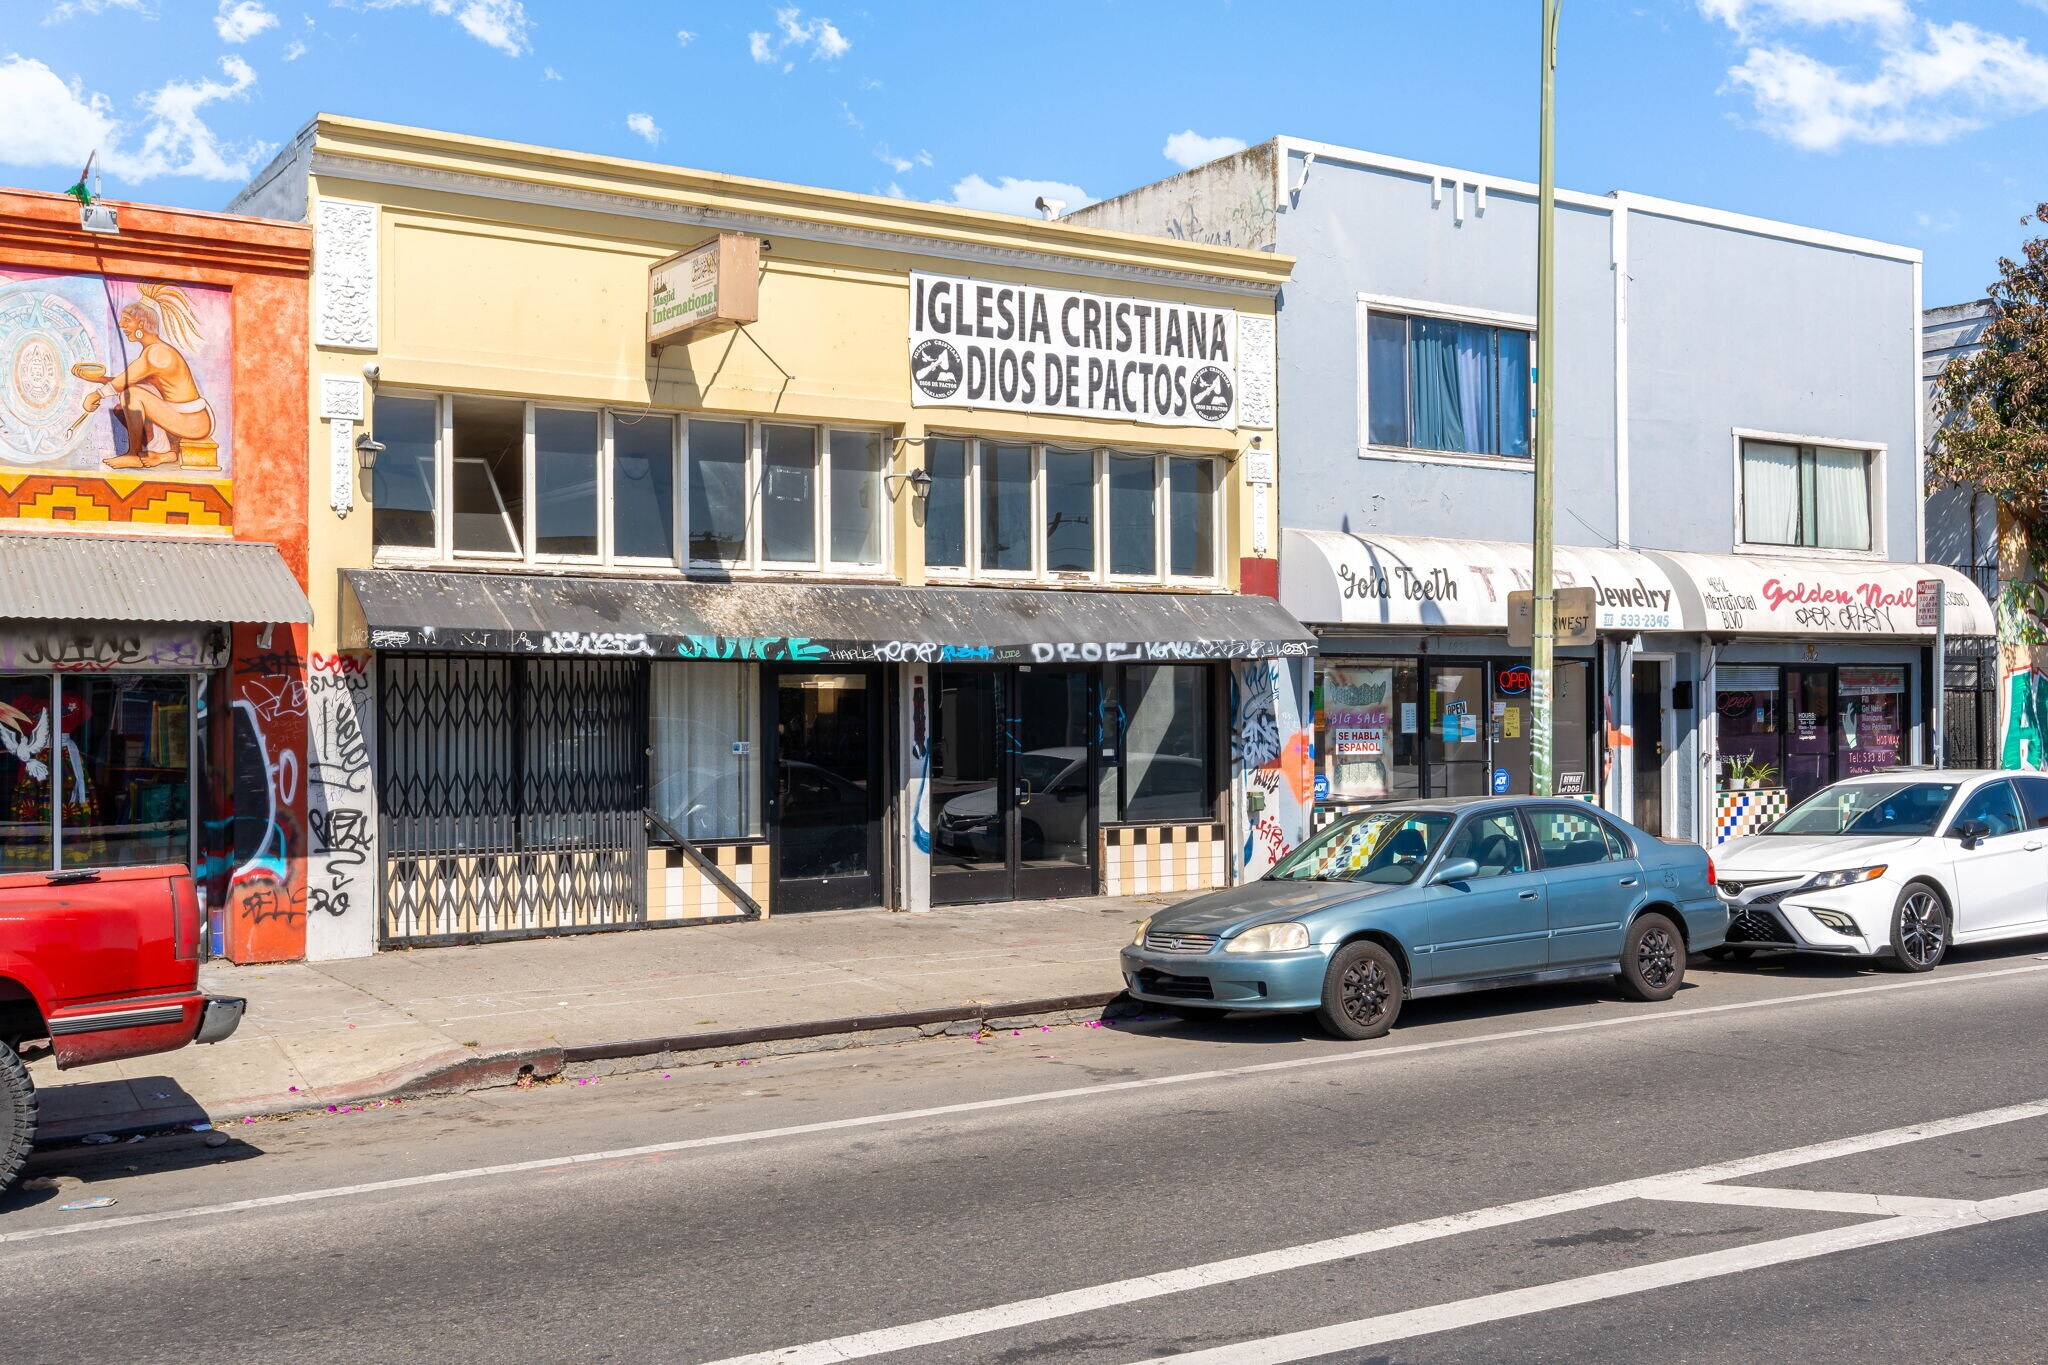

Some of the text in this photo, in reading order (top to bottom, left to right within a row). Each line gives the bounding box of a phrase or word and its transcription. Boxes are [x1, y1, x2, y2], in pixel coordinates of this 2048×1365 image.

[652, 285, 718, 325] International
[653, 289, 676, 307] Masjid
[915, 278, 1229, 363] IGLESIA CRISTIANA
[967, 345, 1188, 417] DIOS DE PACTOS
[1337, 563, 1391, 600] Gold
[1394, 566, 1458, 602] Teeth
[1594, 575, 1671, 612] Jewelry
[1762, 578, 1854, 611] Golden
[1619, 613, 1670, 628] 533-2345
[1721, 610, 1743, 630] BLVD
[1500, 671, 1532, 688] OPEN
[1447, 702, 1466, 715] OPEN
[1331, 713, 1385, 725] BIG SALE
[1338, 731, 1380, 740] SE HABLA
[1338, 741, 1381, 752] ESPAÑOL
[1848, 752, 1861, 763] Tel:
